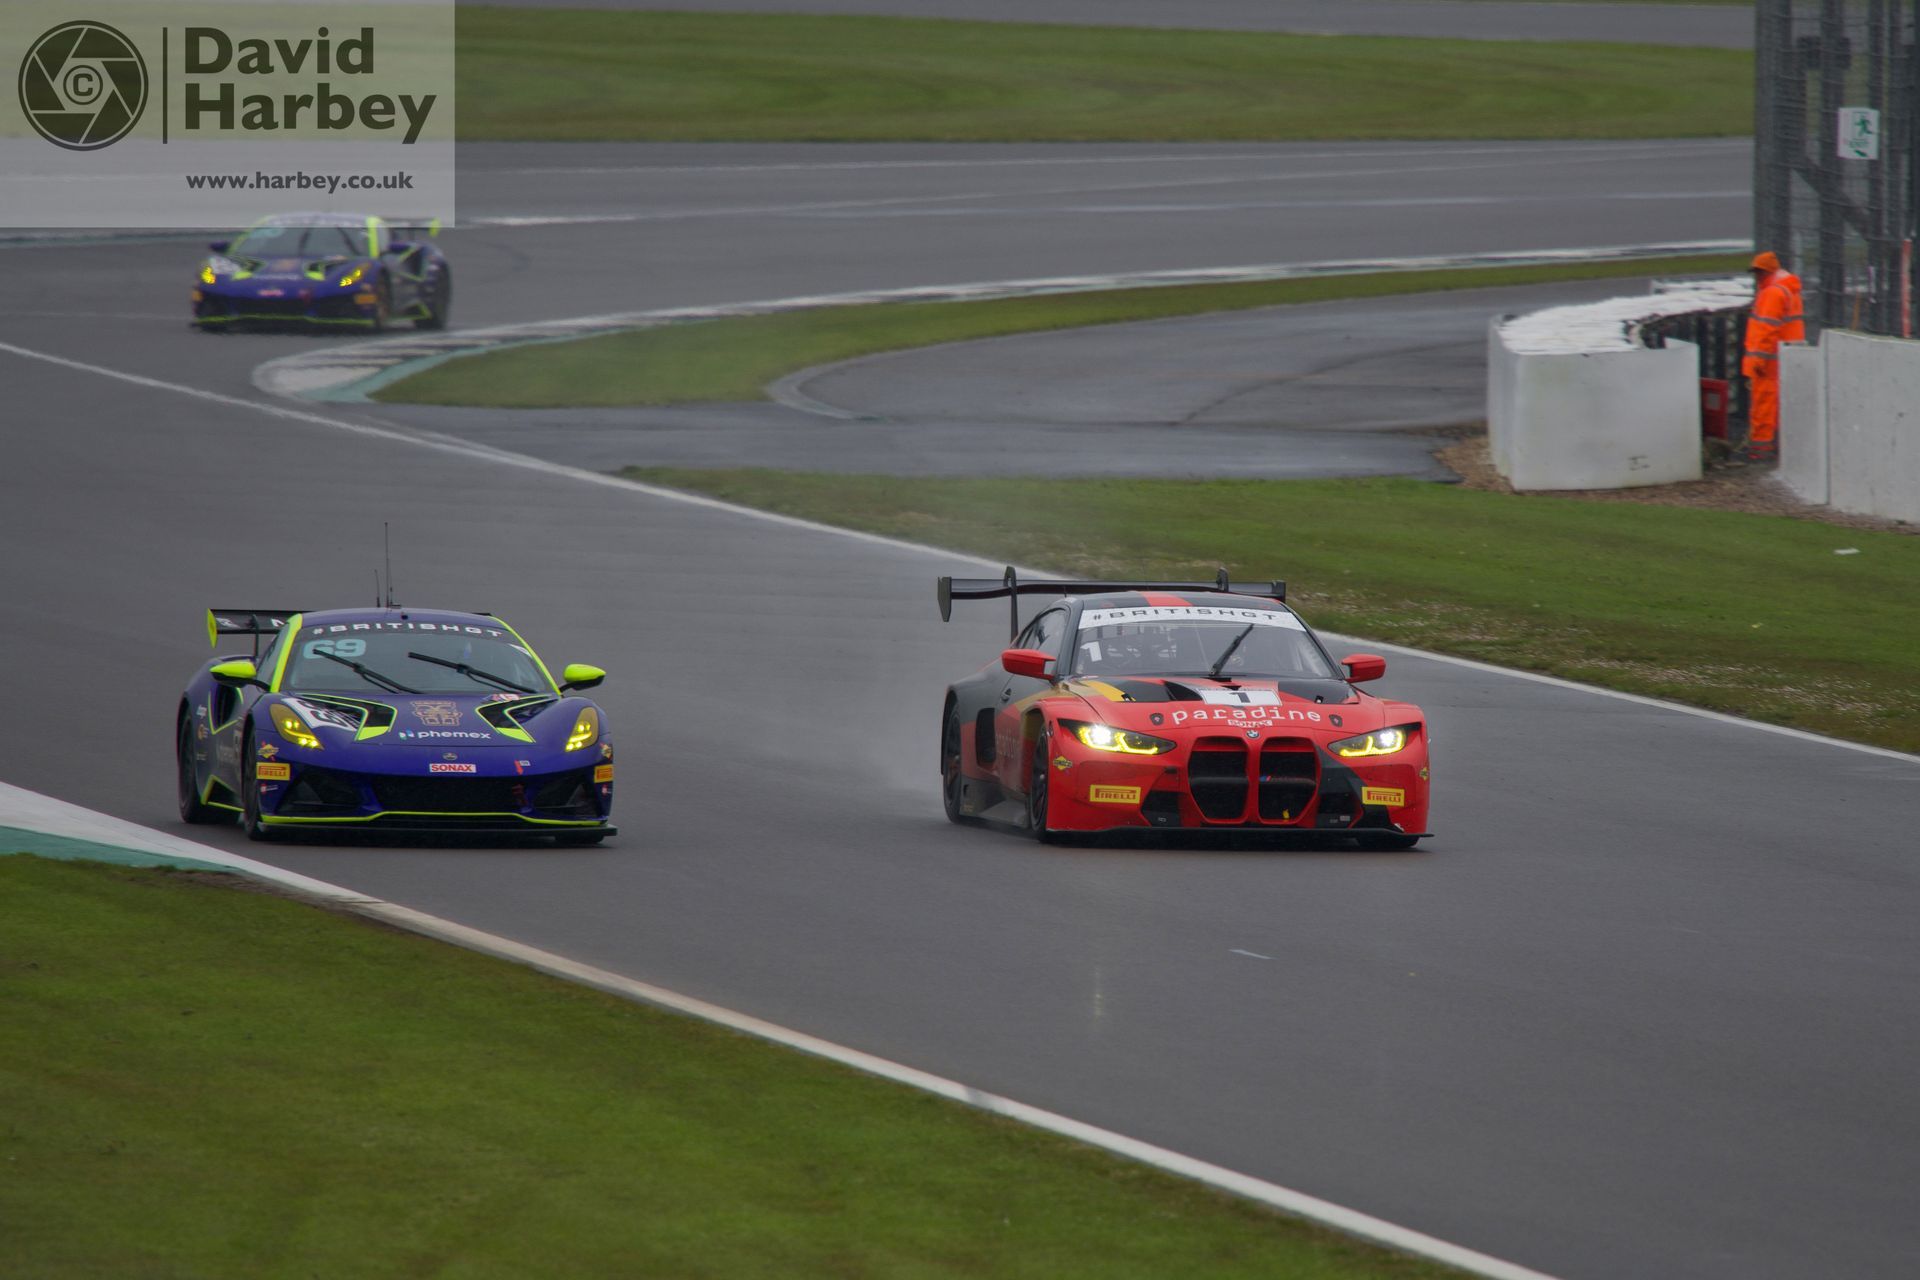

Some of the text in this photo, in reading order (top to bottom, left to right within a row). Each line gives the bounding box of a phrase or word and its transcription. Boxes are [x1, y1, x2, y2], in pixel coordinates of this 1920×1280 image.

[1093, 608, 1278, 621] #BRITISHGT
[312, 622, 503, 637] #BRITISHGT
[303, 638, 366, 659] 69
[1080, 641, 1102, 662] 1
[1229, 692, 1251, 703] 1
[1172, 706, 1321, 725] paradine
[417, 730, 491, 740] phemex
[431, 764, 473, 772] SONAX
[1094, 788, 1136, 800] PIRELLI
[1366, 790, 1401, 802] PIRELLI
